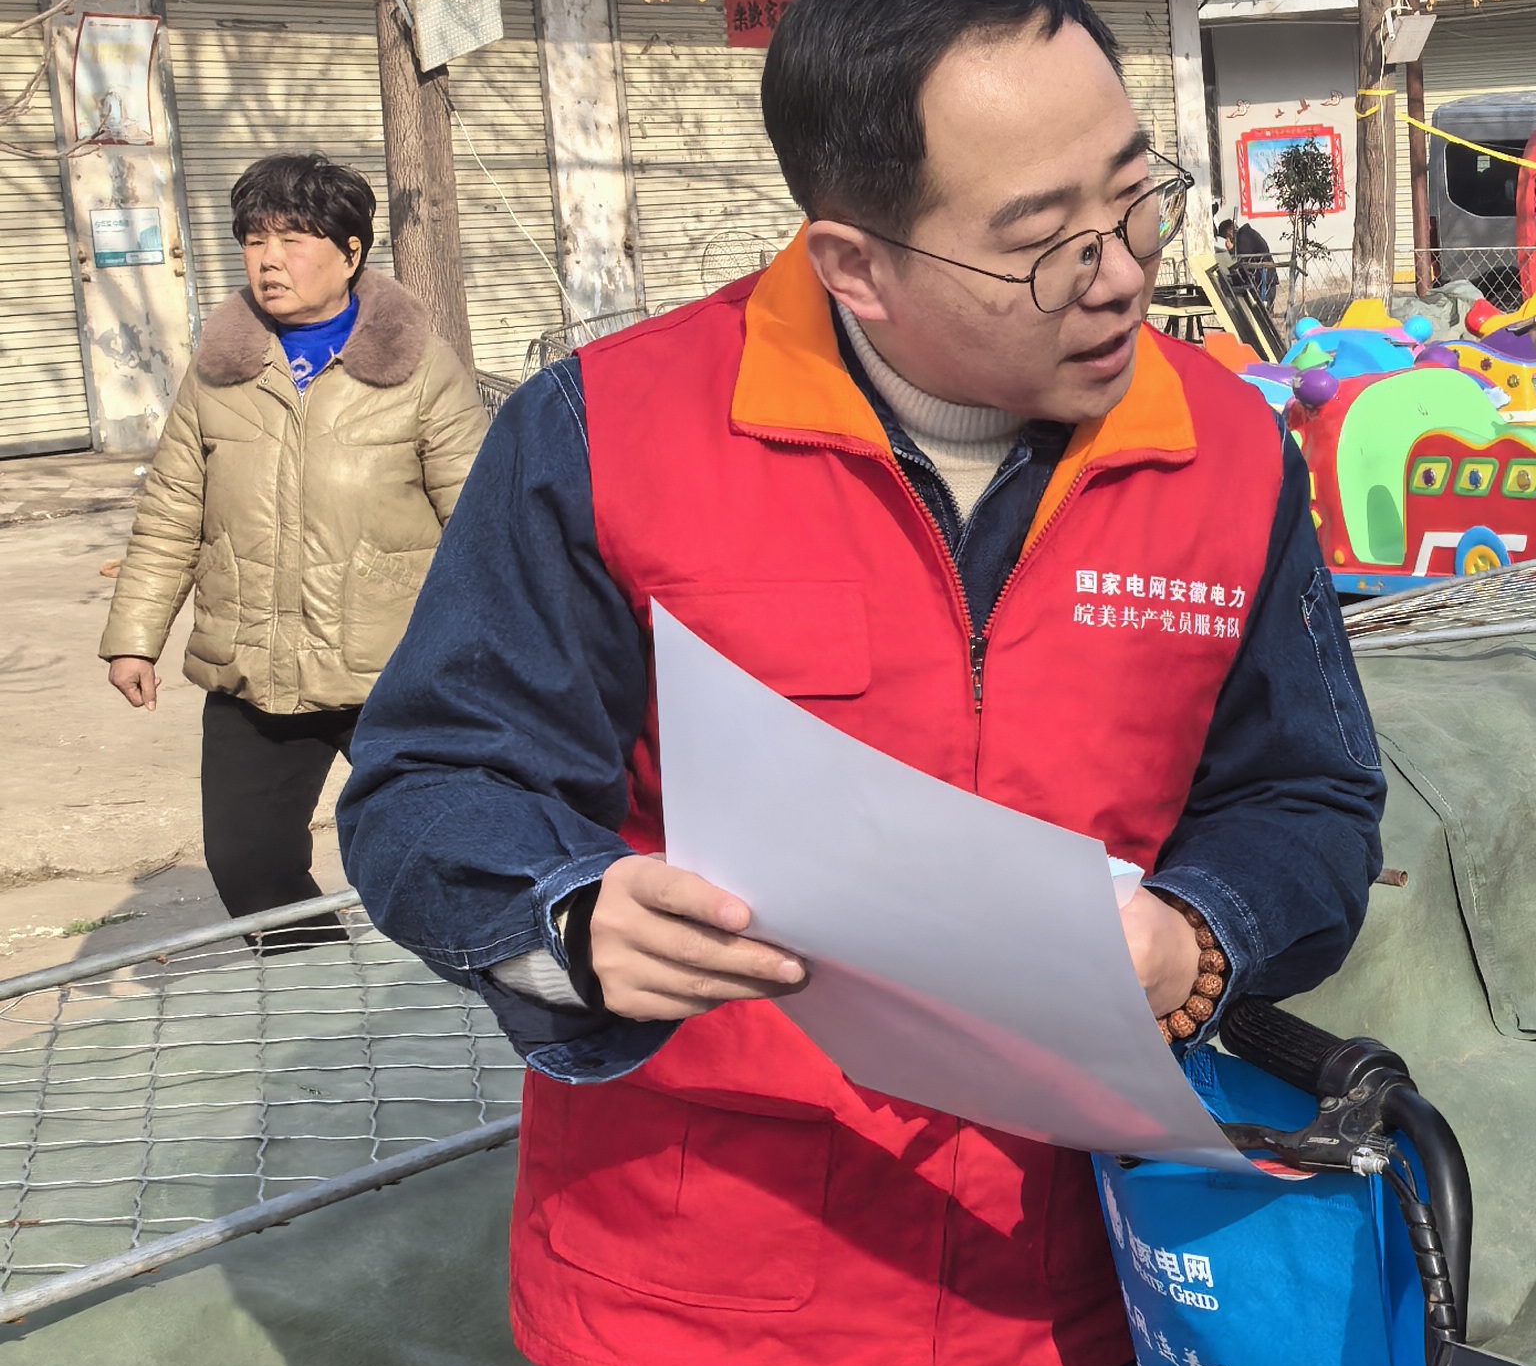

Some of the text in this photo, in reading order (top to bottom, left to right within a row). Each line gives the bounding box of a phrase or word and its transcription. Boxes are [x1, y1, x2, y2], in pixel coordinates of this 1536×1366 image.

[1075, 569, 1247, 609] 国家电网安徽电力
[1073, 602, 1241, 639] 皖美共产党员服务队
